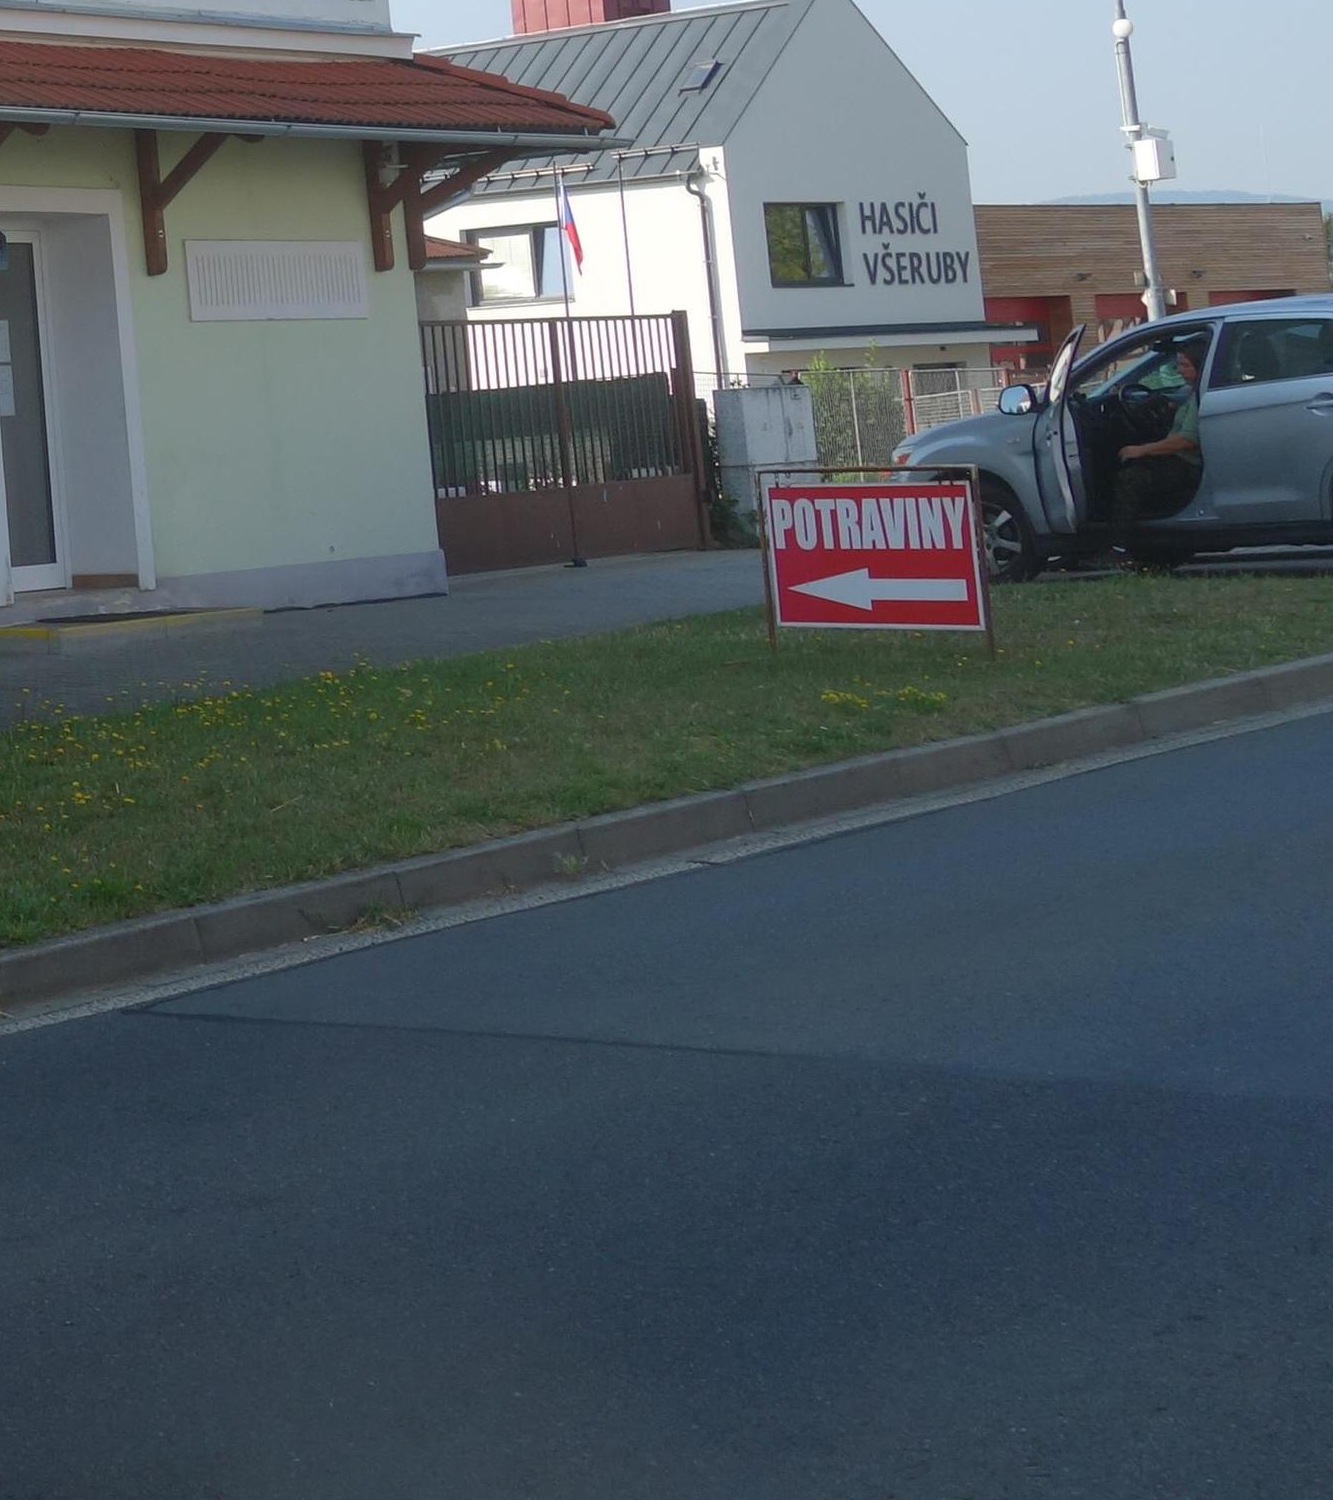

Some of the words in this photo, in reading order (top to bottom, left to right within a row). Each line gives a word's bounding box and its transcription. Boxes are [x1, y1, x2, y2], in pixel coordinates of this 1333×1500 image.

[859, 191, 938, 235] HASIČI
[862, 242, 970, 286] VŠERUBY
[771, 496, 966, 551] POTRAVINY
